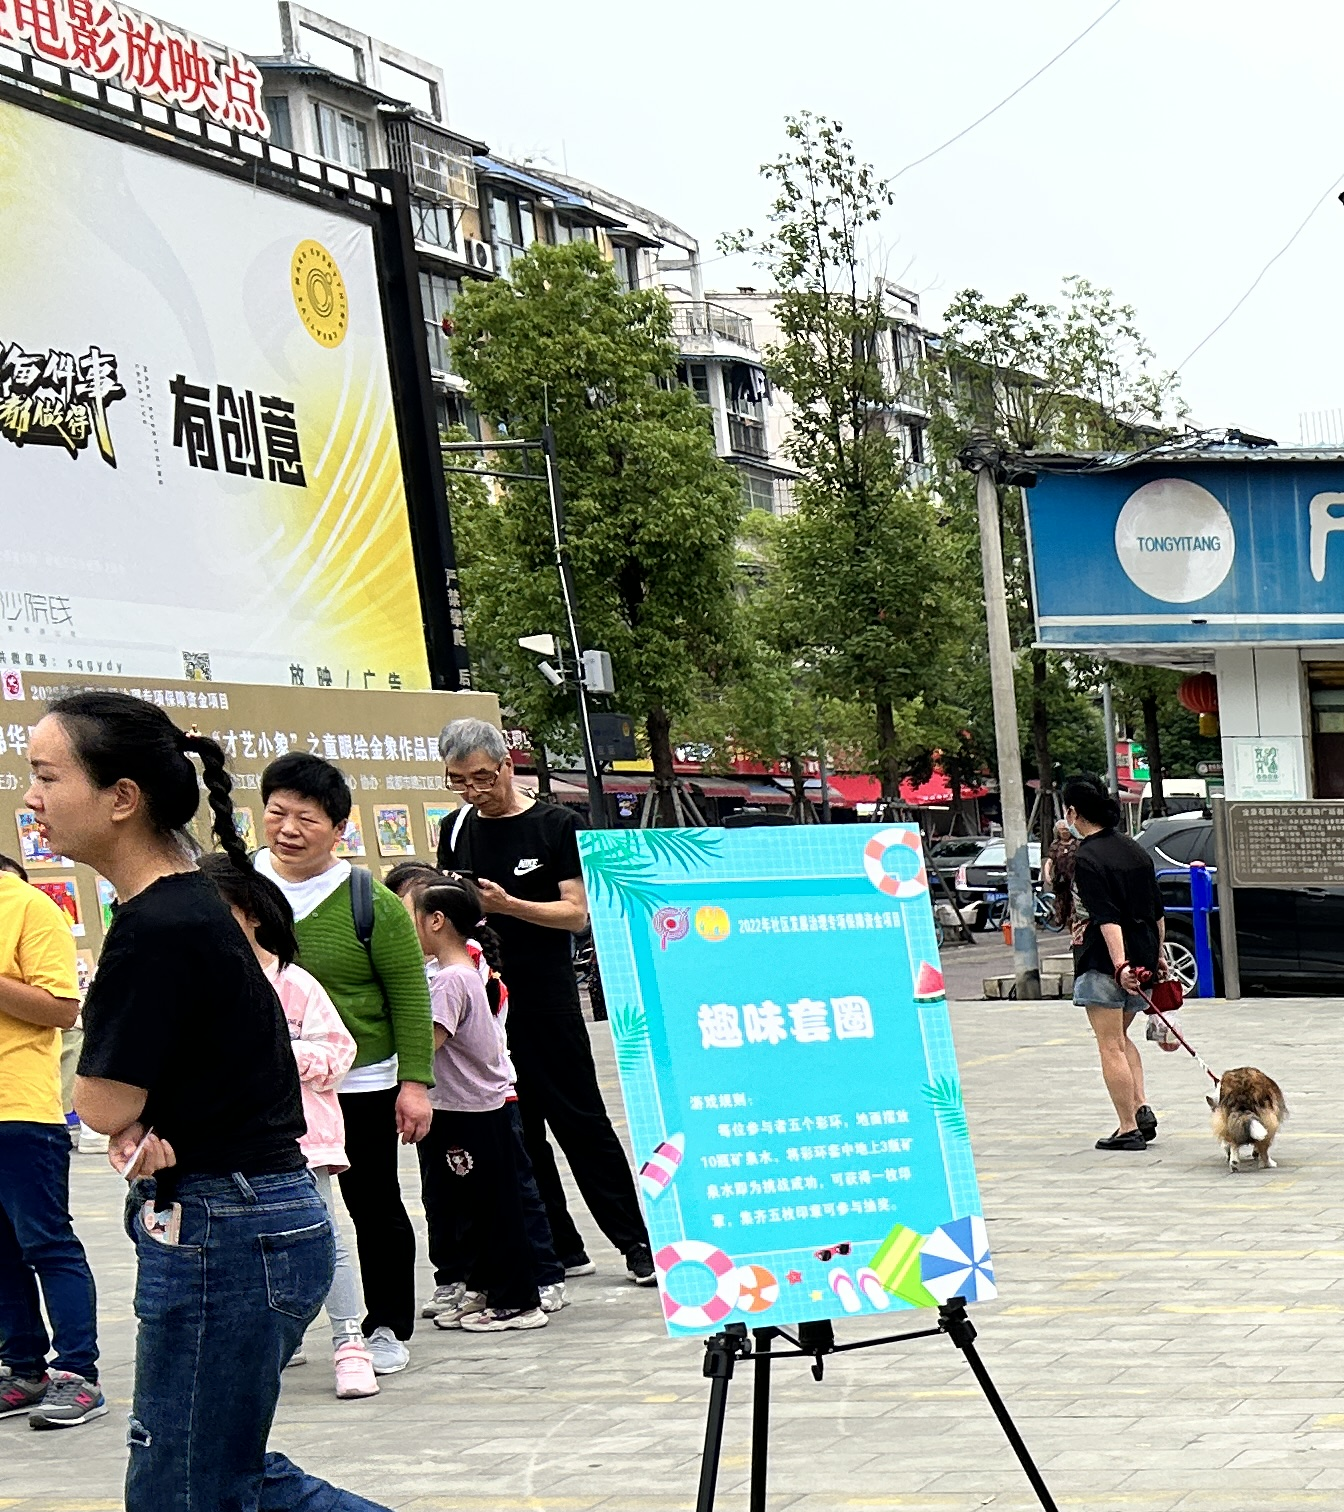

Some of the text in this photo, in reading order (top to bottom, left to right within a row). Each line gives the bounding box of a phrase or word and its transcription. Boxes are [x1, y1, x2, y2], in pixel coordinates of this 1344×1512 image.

[0, 0, 265, 132] 电影放映点
[169, 374, 308, 488] 有创意
[1136, 534, 1222, 552] TONGYITANG
[697, 995, 875, 1050] 趣味套圈
